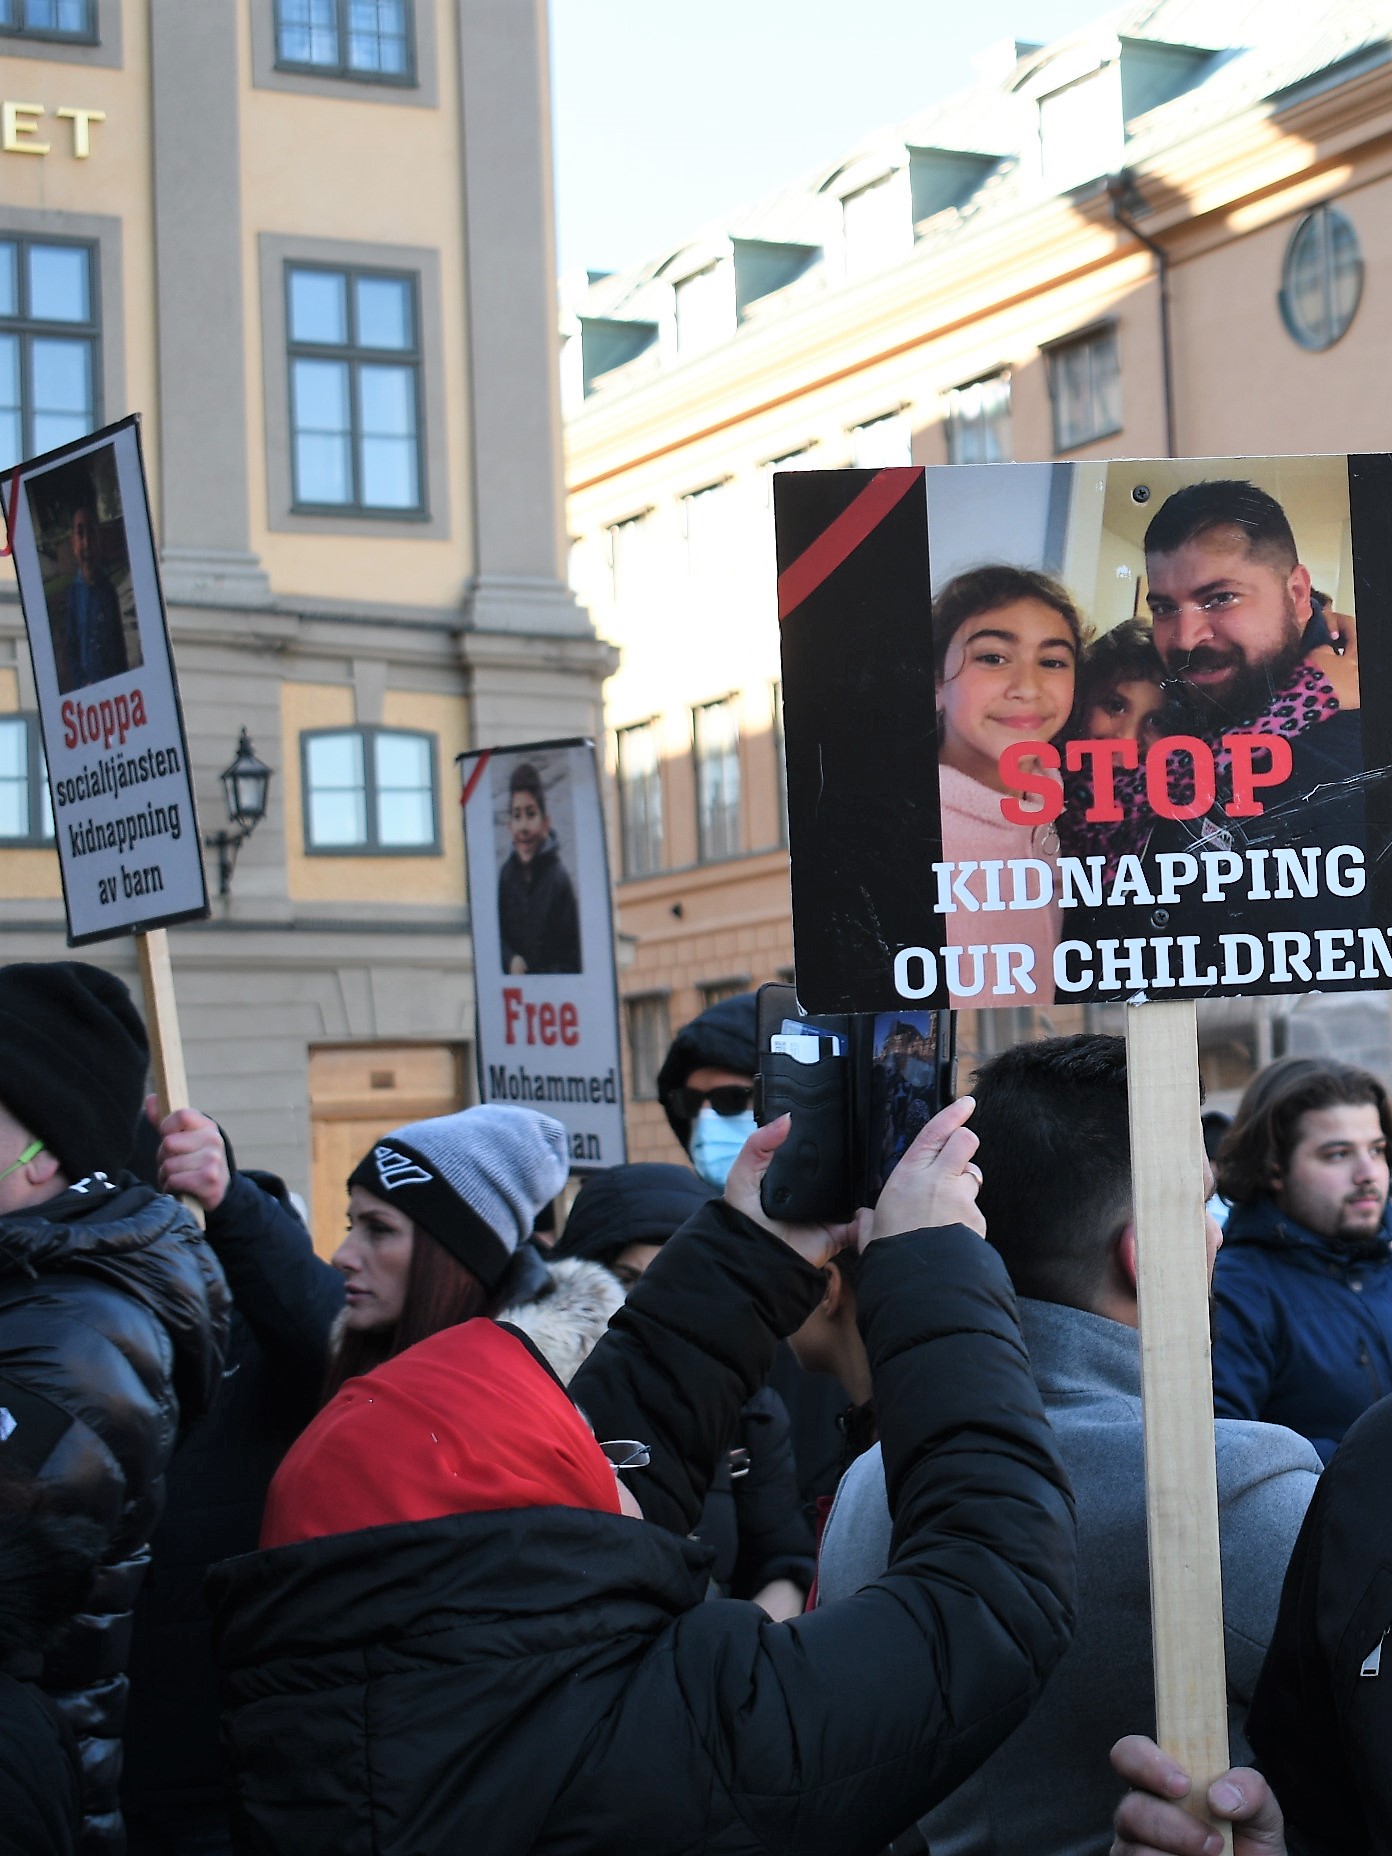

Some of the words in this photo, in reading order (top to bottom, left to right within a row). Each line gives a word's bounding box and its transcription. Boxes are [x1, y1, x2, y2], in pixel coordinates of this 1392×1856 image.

[3, 101, 106, 159] ET
[61, 689, 148, 750] Stoppa
[56, 747, 181, 807] socialtjänsten
[1000, 735, 1294, 826] STOP
[68, 802, 182, 858] kidnappning
[99, 876, 118, 905] av
[121, 864, 164, 899] barn
[931, 844, 1367, 914] KIDNAPPING
[893, 942, 1037, 999] OUR
[503, 987, 580, 1046] Free
[489, 1064, 617, 1104] Mohammed
[567, 1131, 602, 1161] an
